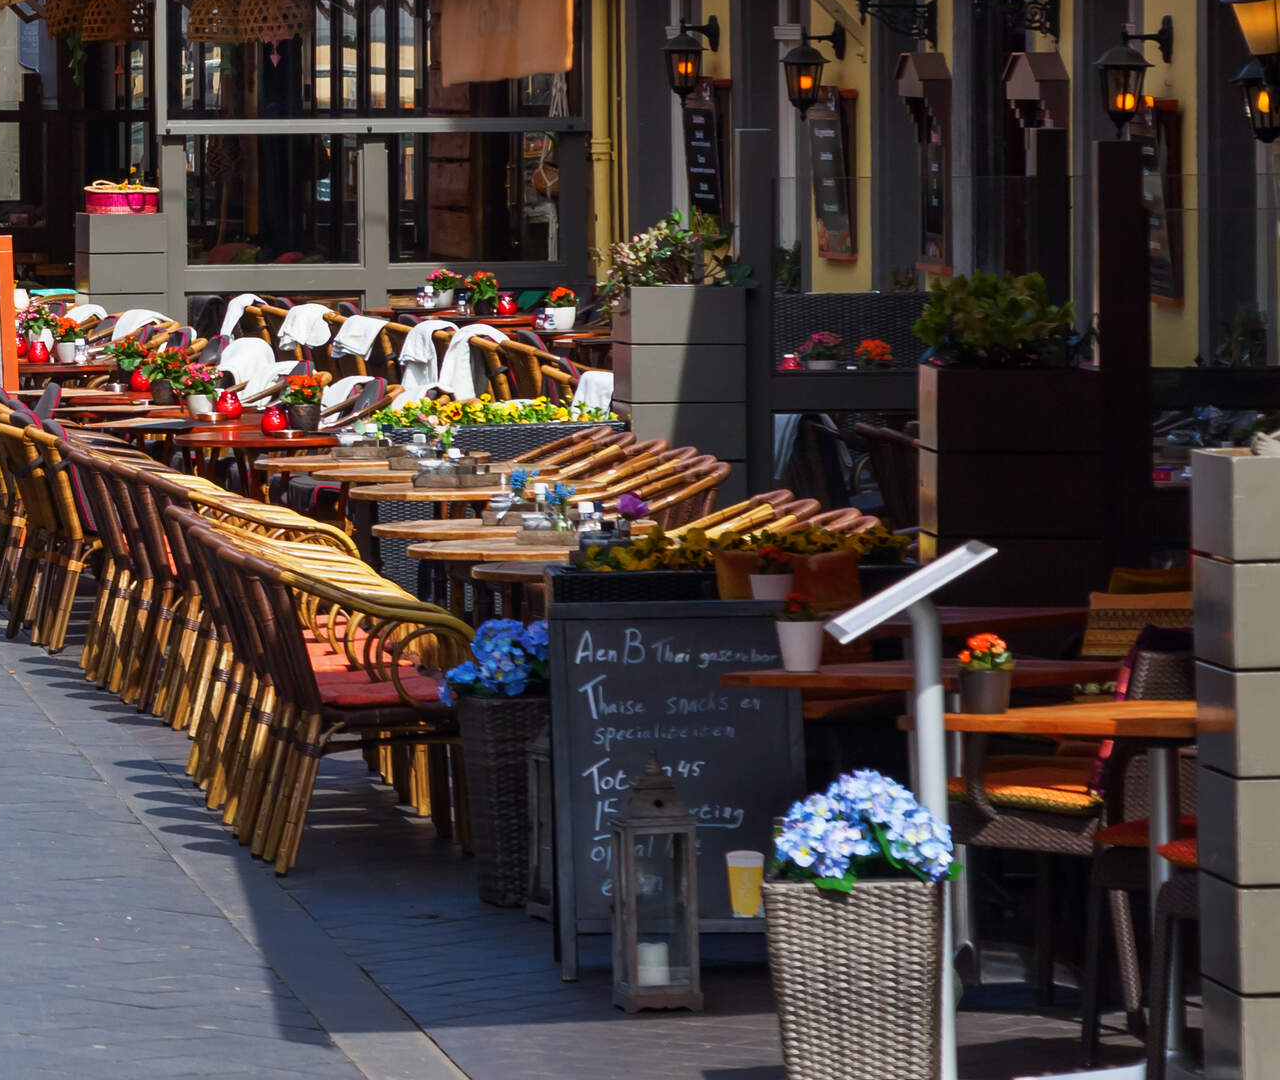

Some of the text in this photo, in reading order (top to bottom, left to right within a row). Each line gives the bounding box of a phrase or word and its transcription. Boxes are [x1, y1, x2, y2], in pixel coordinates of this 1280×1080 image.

[651, 636, 691, 663] Thai
[578, 674, 648, 720] Thaise
[739, 697, 761, 712] en
